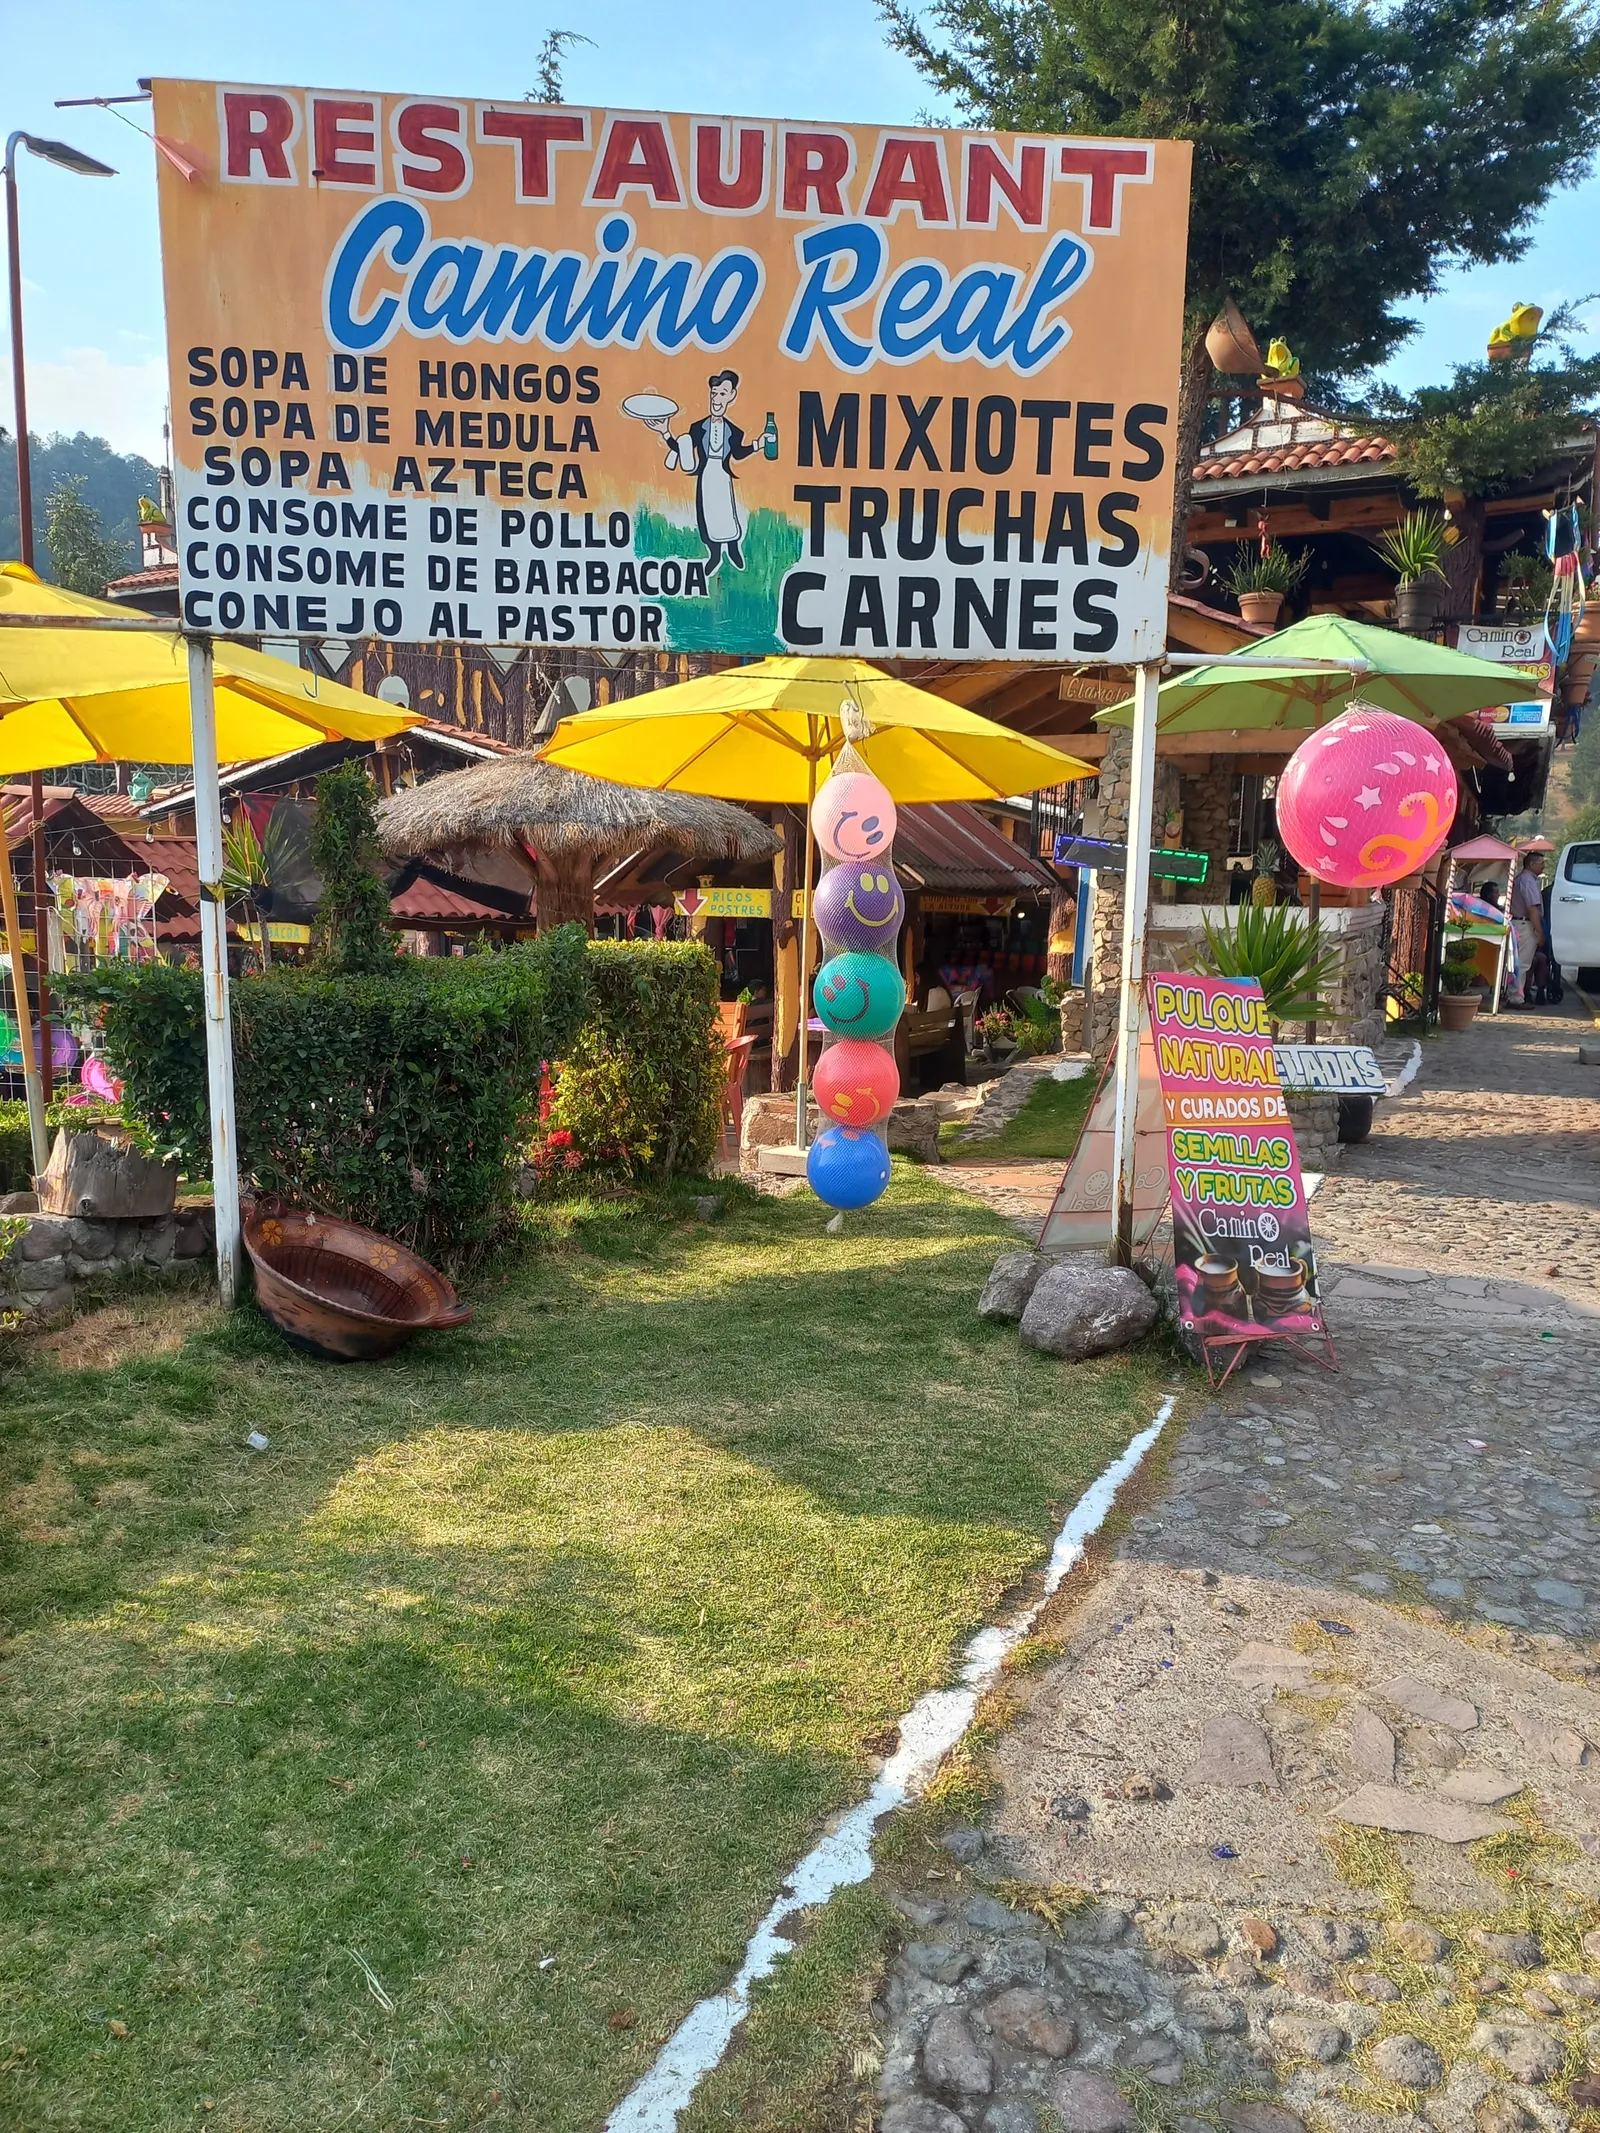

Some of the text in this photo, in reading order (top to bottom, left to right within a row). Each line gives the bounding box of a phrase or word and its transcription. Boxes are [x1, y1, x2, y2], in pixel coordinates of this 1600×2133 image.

[222, 91, 1149, 231] RESTAURANT
[328, 199, 1087, 370] Camino Real
[188, 349, 601, 403] SOPA DE HONGOS
[191, 396, 600, 452] SOPA DE MEDULA
[797, 391, 1168, 482] MIXIOTES
[206, 446, 588, 499] SOPA AZTECA
[187, 496, 631, 549] CONSOME DE POLLO
[794, 484, 1140, 567] TRUCHAS
[186, 541, 708, 597] CONSOME DE BARBACOA
[185, 590, 665, 643] CONEJO AL PASTOR
[781, 571, 1119, 653] CARNES
[1501, 643, 1537, 658] Real
[710, 904, 763, 915] POSTRES
[713, 892, 752, 903] RICOS
[1156, 985, 1271, 1034] PULQUE
[1160, 1036, 1280, 1085] NATURAL
[1166, 1096, 1288, 1119] Y CURADOS DE
[1172, 1130, 1290, 1168] SEMILLAS
[1176, 1169, 1295, 1206] Y FRUTAS
[1248, 1244, 1290, 1268] Real
